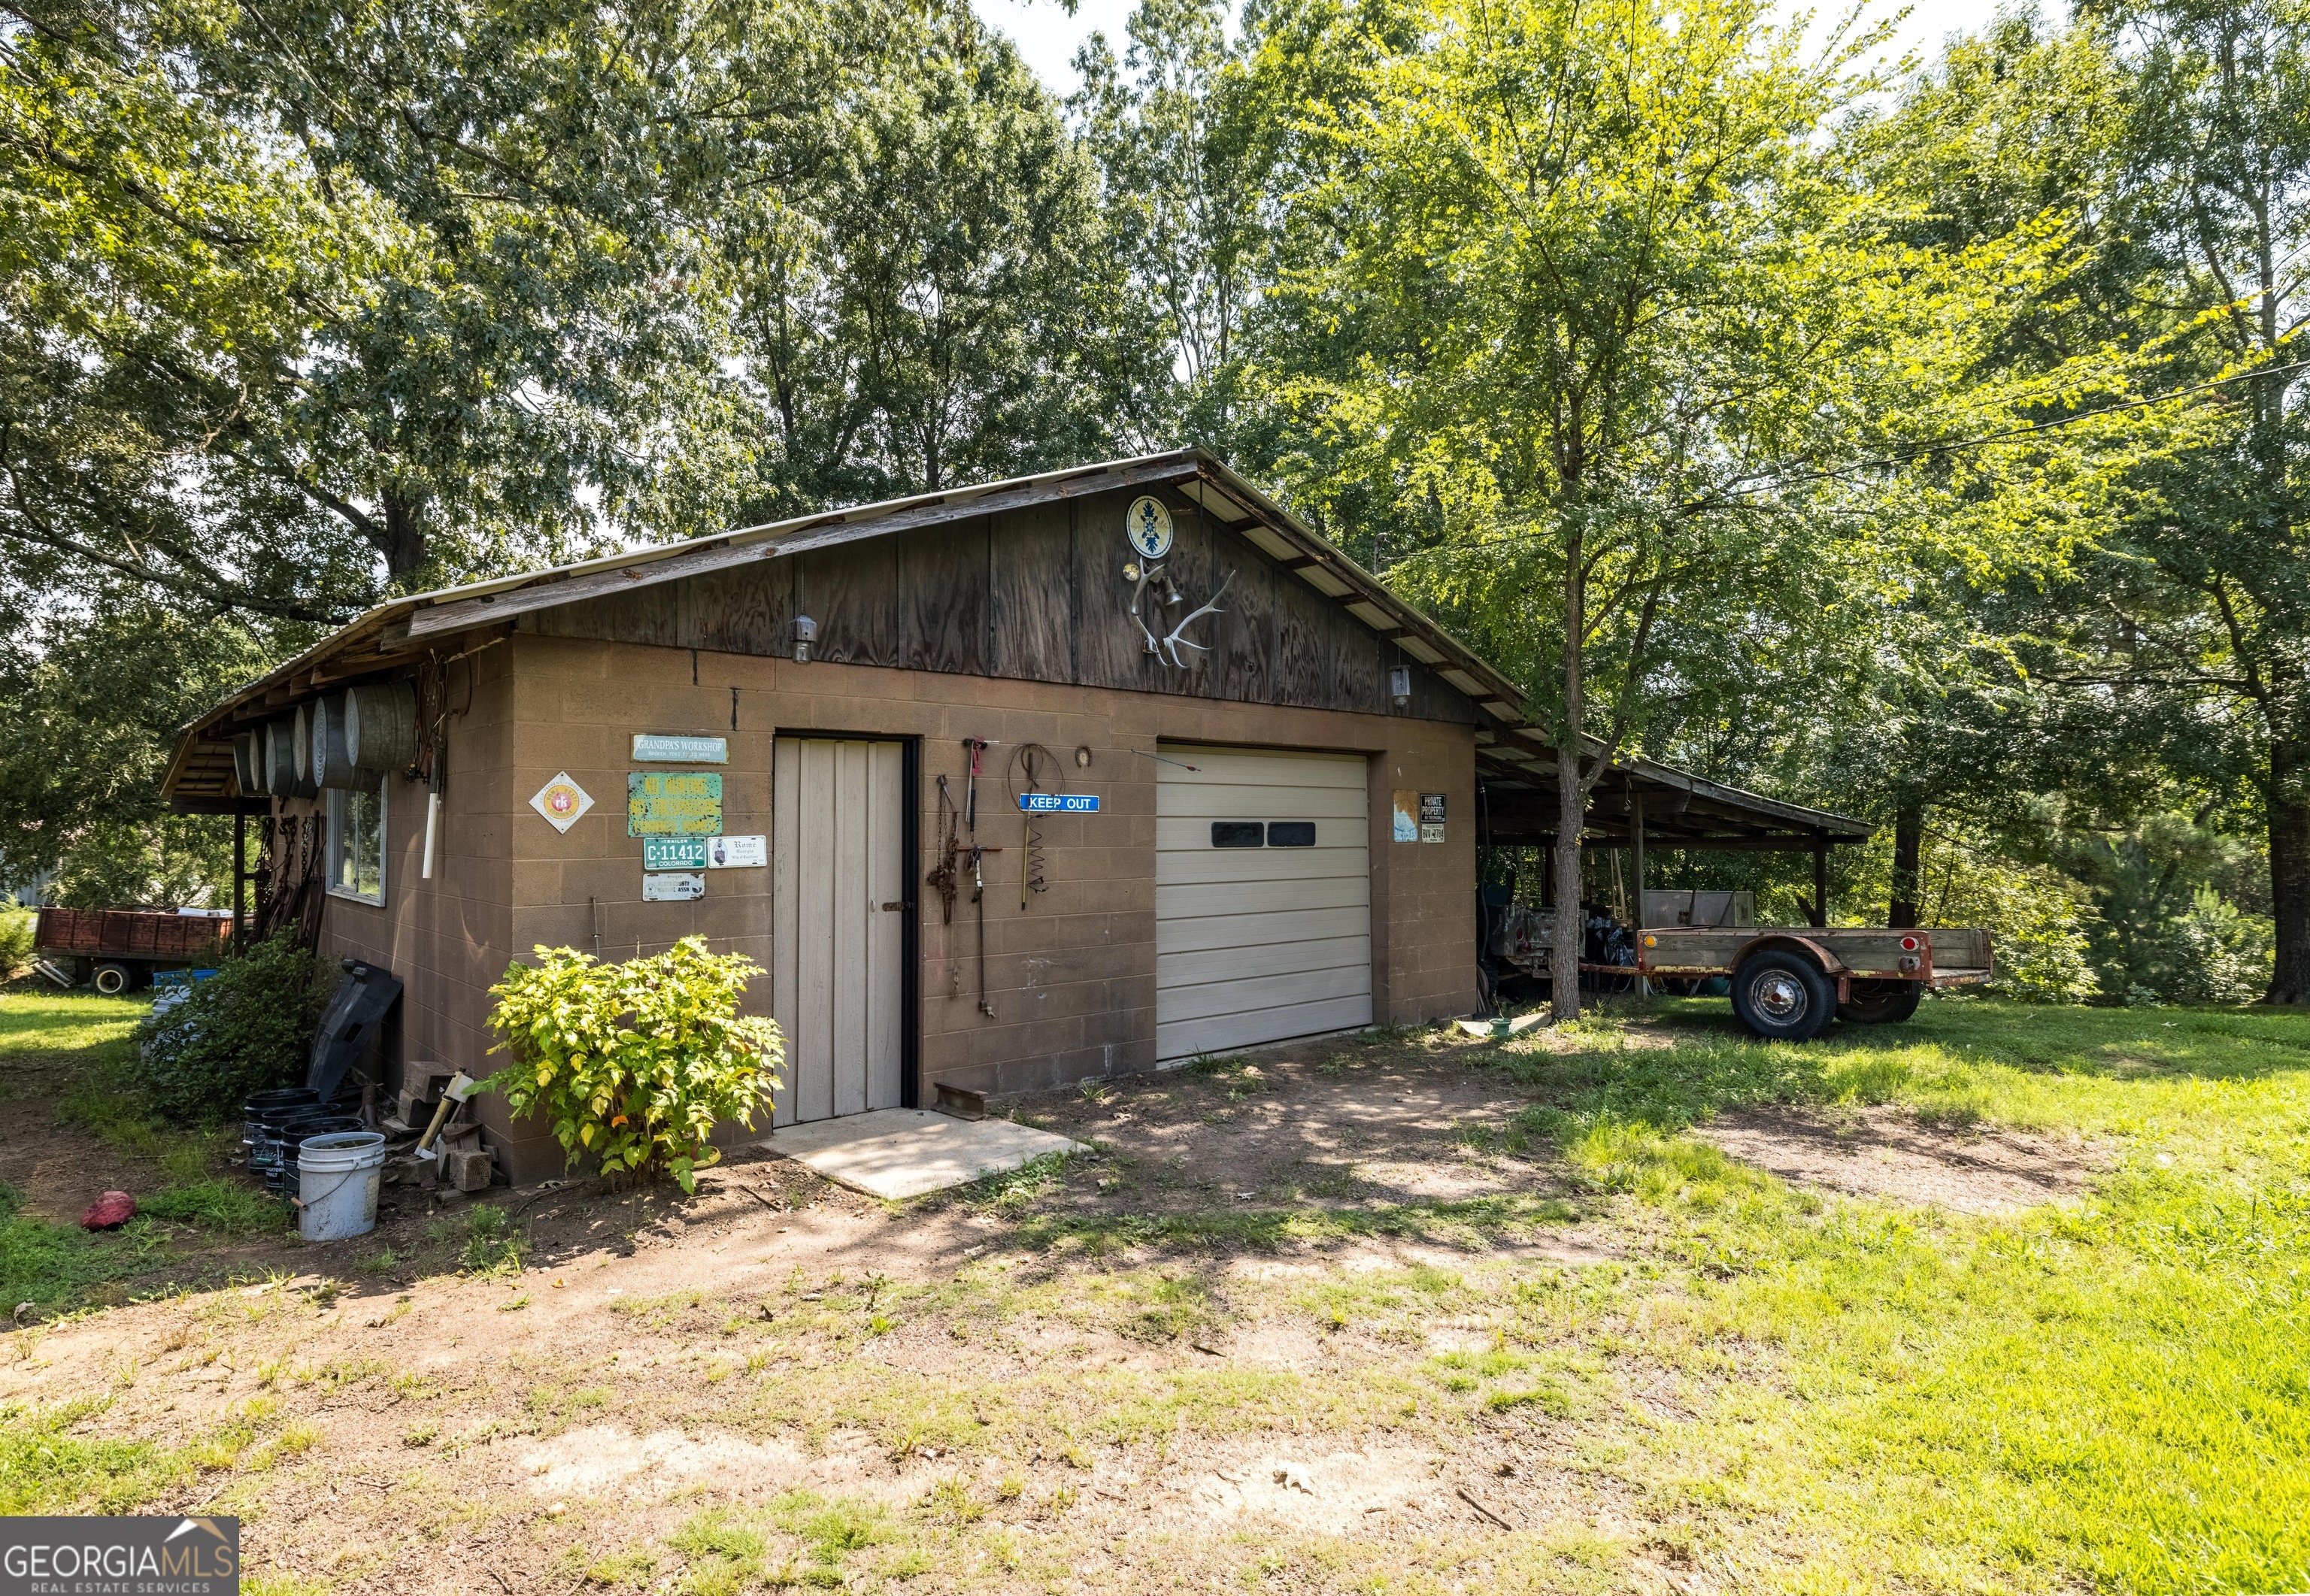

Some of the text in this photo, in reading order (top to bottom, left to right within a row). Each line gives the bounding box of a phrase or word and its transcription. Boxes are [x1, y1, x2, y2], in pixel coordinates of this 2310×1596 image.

[638, 739, 722, 752] GRANDPA'S WORKSHOP
[544, 780, 562, 792] PREVENT
[565, 781, 580, 792] FOREST
[644, 777, 708, 795] NO HUNTING
[651, 798, 722, 816] TRESPASSING
[1029, 797, 1091, 809] KEEP OUT
[1424, 797, 1442, 806] PRIVATE
[549, 808, 573, 817] COMPANY
[1422, 806, 1445, 816] PROPERTY
[733, 840, 756, 849] Rome
